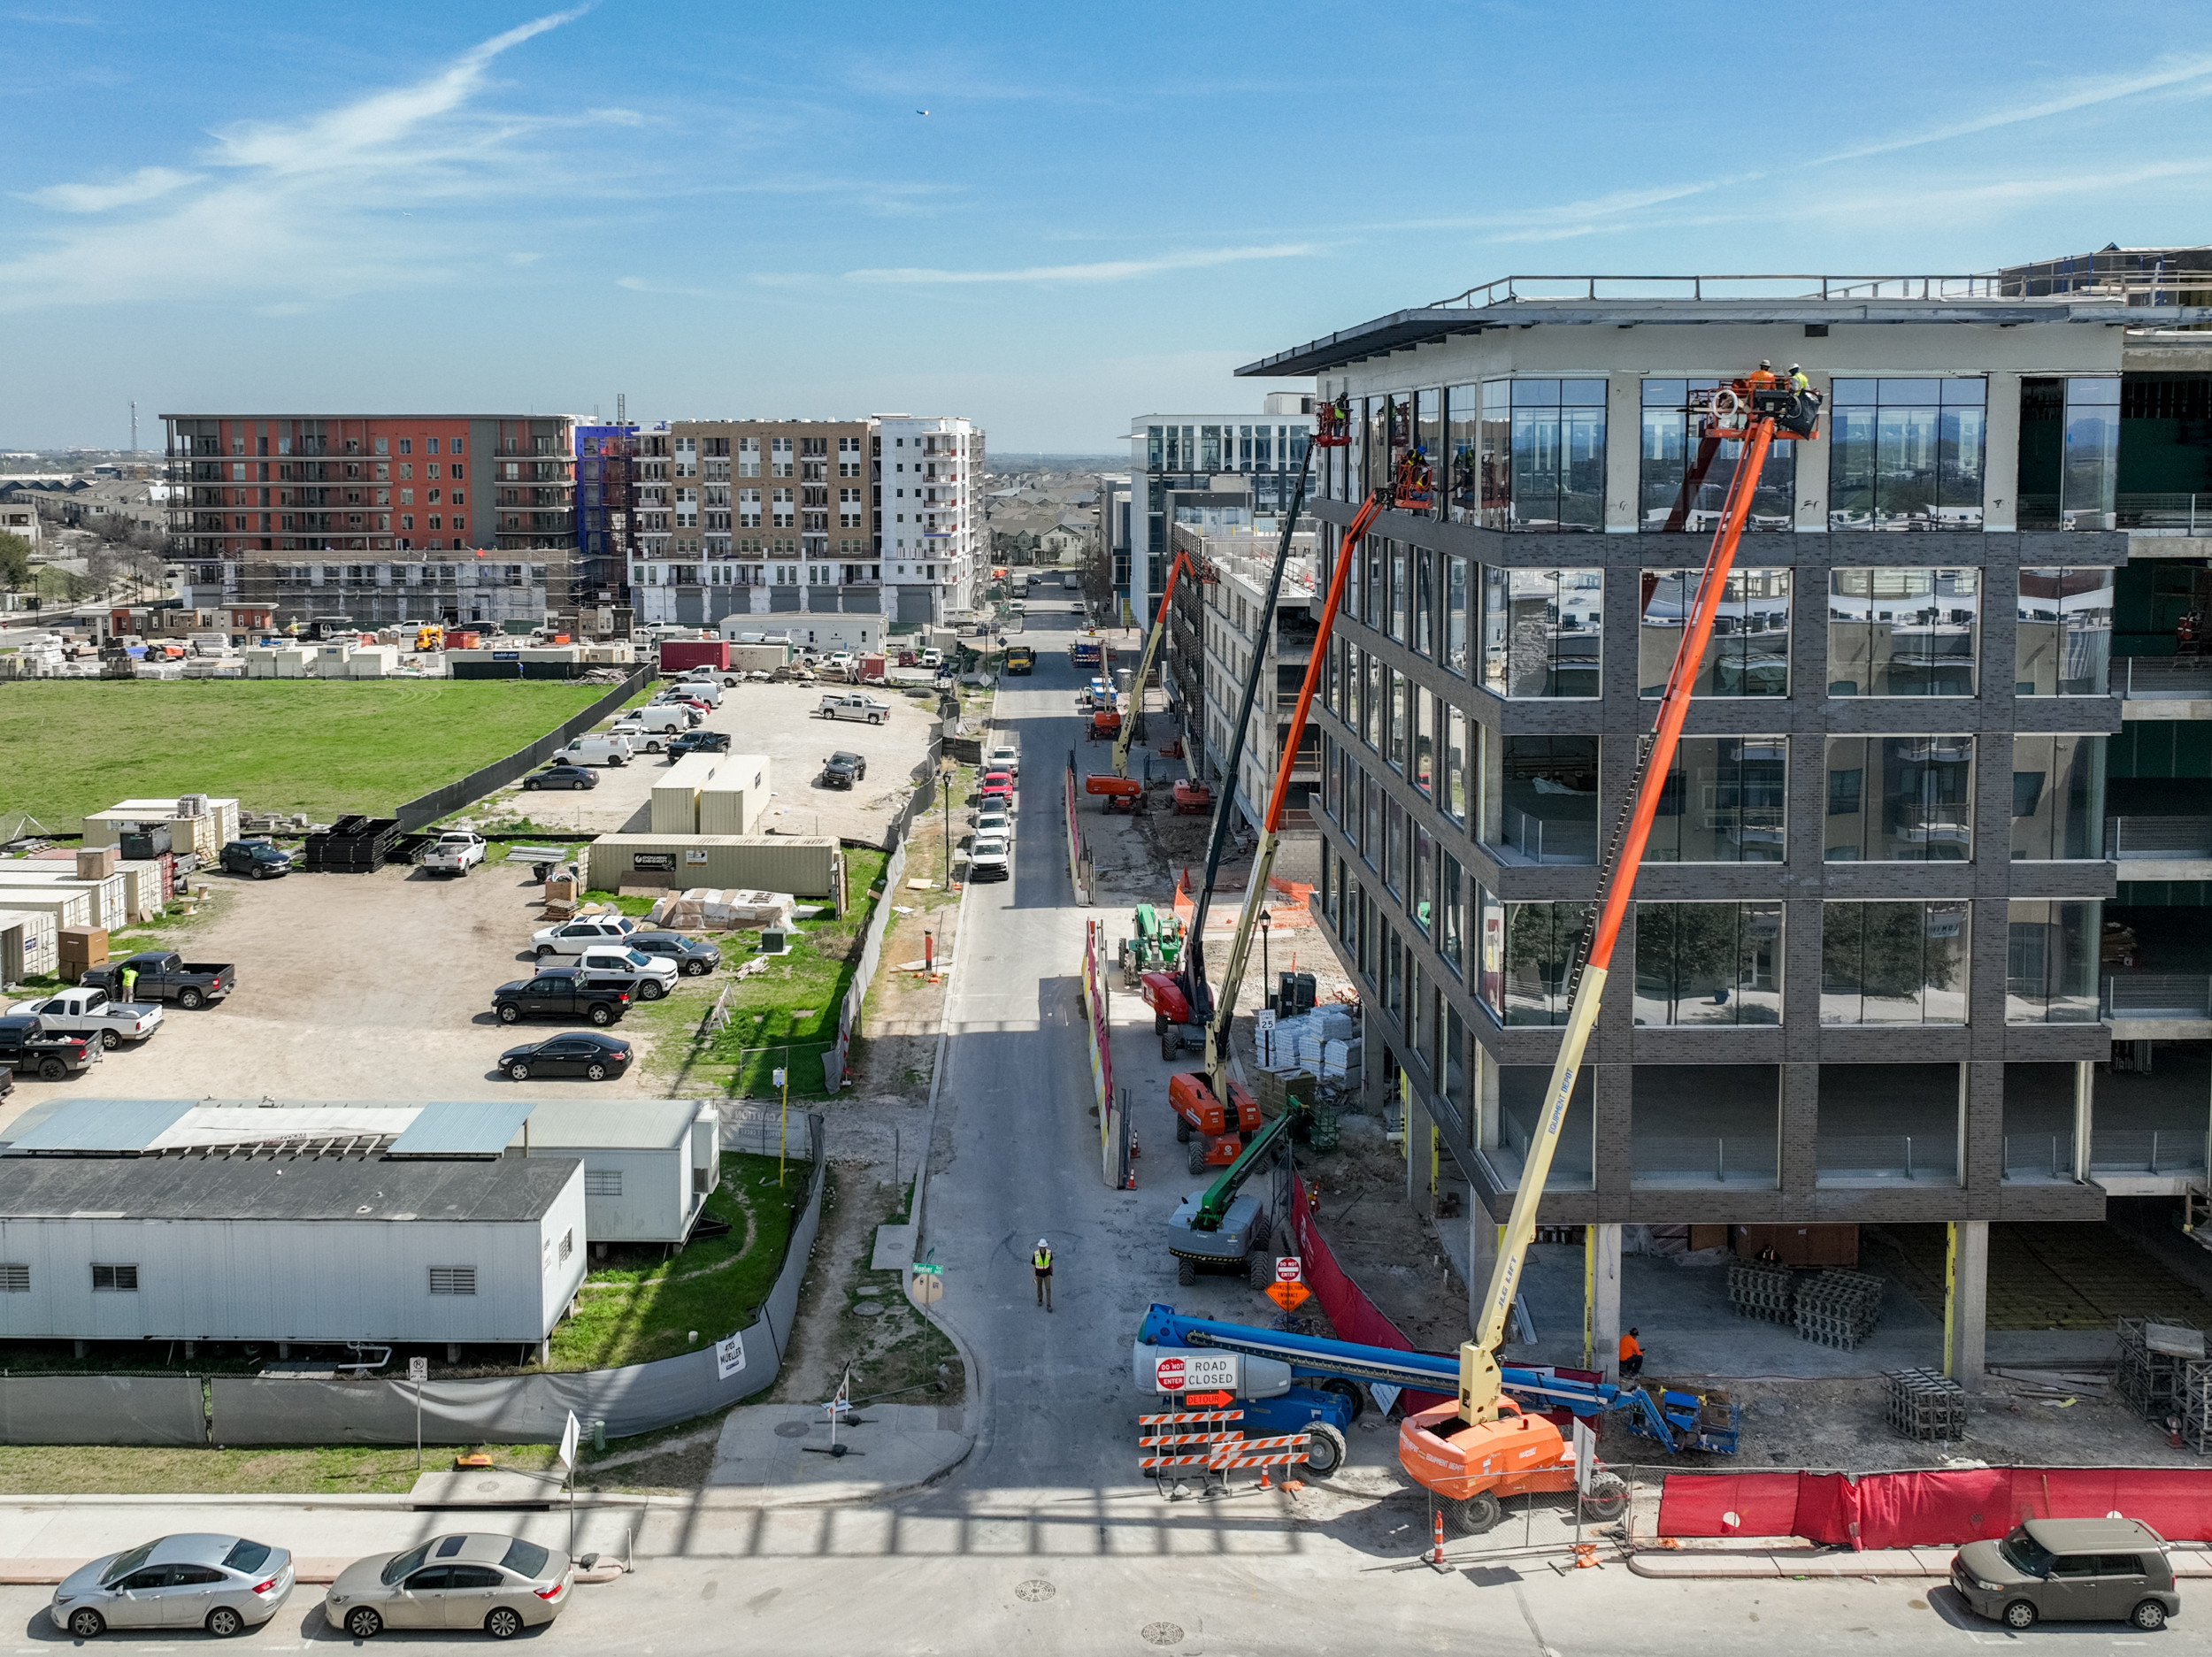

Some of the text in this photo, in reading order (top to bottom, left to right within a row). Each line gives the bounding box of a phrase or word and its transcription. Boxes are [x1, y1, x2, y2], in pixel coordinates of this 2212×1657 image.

[1548, 1067, 1573, 1135] EQUIPMENT DEPOT
[1498, 1254, 1517, 1309] JLG LIFT
[719, 1346, 742, 1366] MUELLER
[1195, 1361, 1227, 1372] ROAD
[1188, 1373, 1233, 1385] CLOSED
[1187, 1394, 1220, 1404] DETOUR
[1425, 1453, 1448, 1468] EQUIPMENT
[1448, 1461, 1465, 1472] DEPOT
